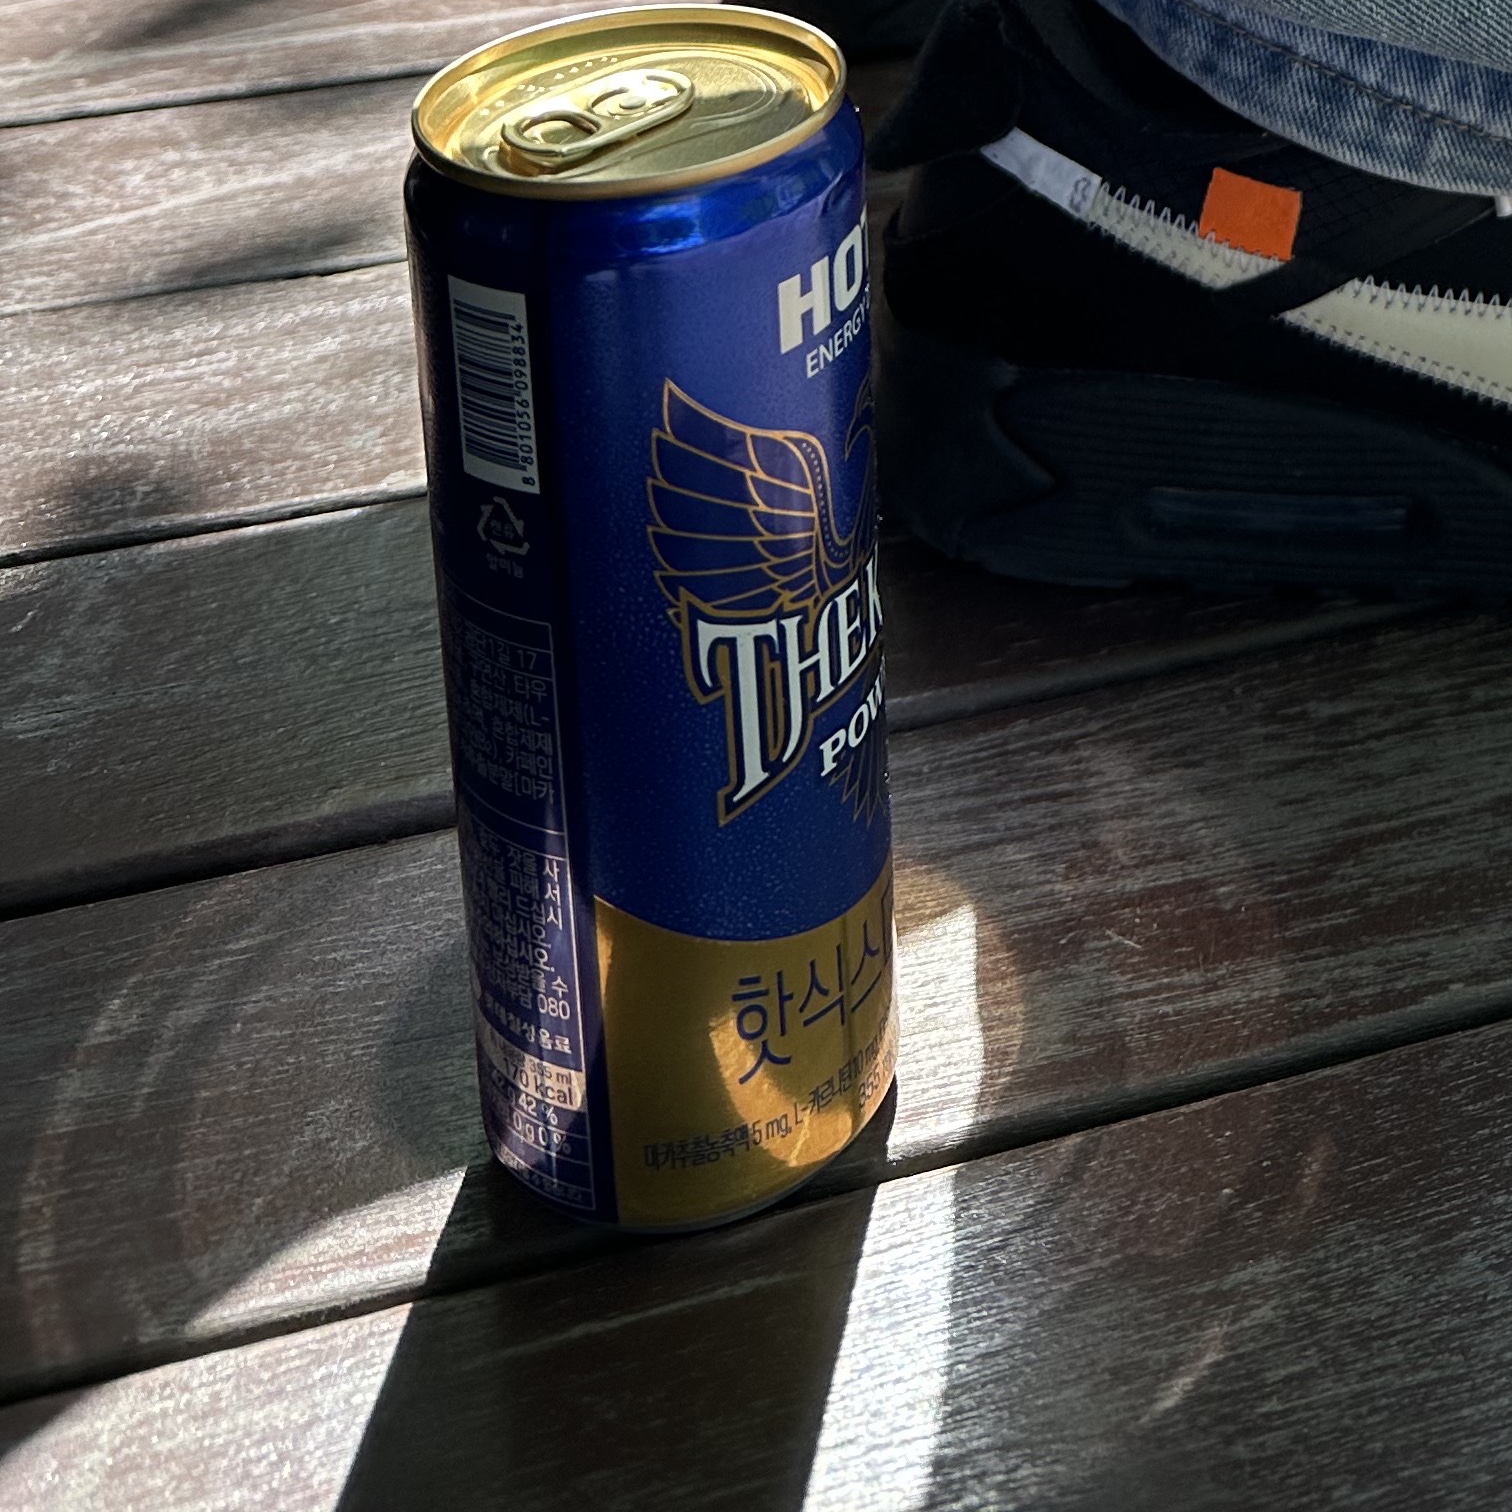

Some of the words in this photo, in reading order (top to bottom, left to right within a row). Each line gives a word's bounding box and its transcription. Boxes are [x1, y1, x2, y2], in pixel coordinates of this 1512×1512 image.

[778, 210, 870, 354] HO
[537, 993, 571, 1020] 080
[732, 919, 882, 1085] 핫식스
